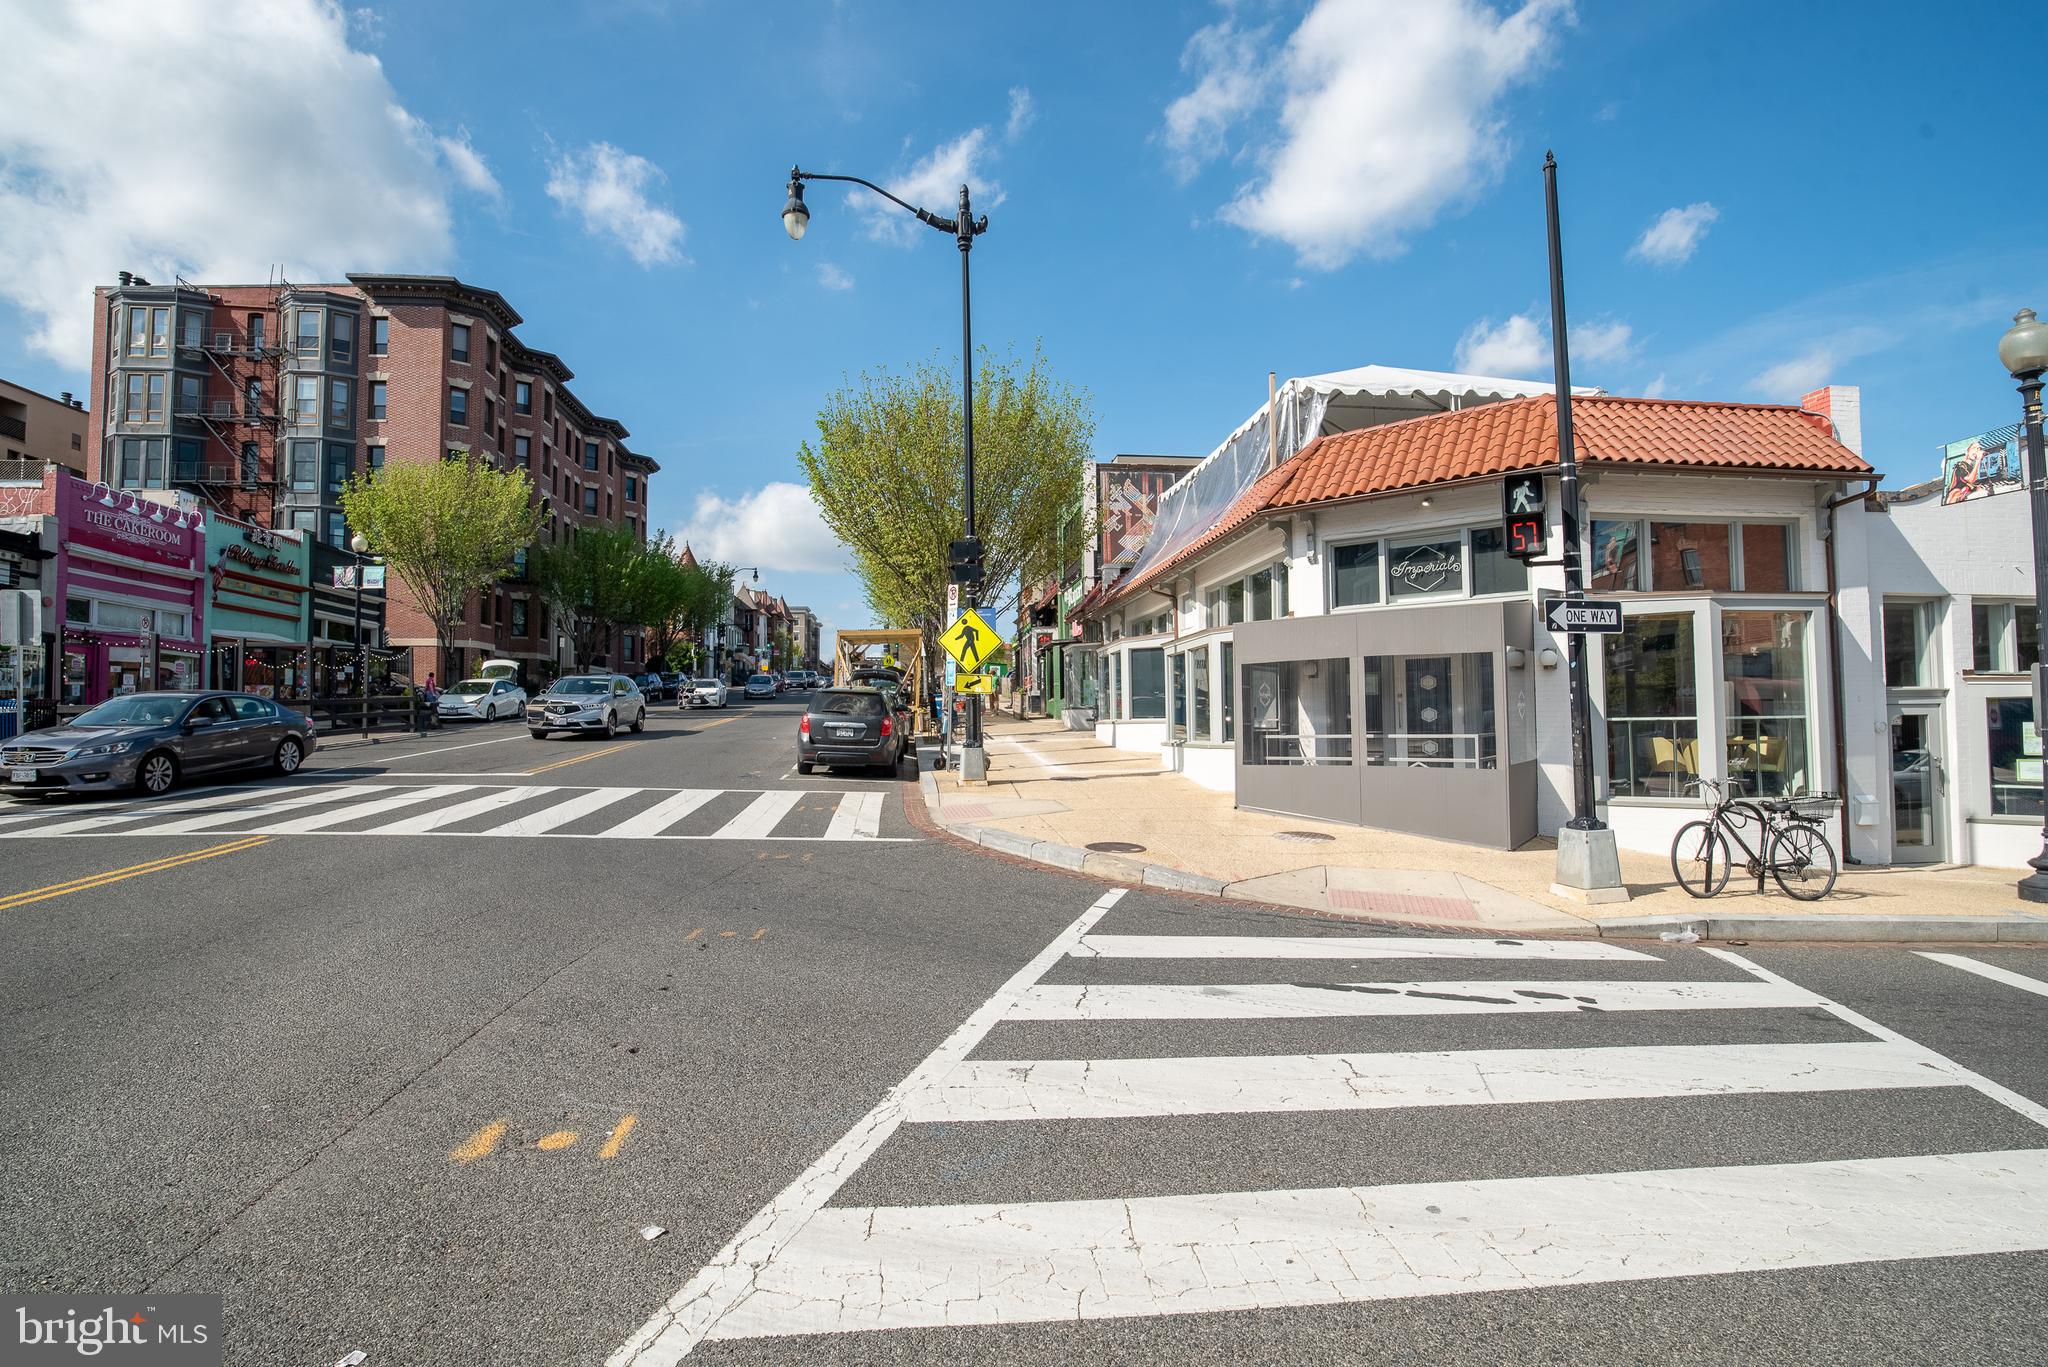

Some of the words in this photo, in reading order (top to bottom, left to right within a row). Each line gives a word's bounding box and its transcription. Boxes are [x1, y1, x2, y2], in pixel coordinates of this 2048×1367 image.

[84, 508, 112, 528] THE
[114, 517, 182, 546] CAKEROOM
[1512, 521, 1538, 551] 57
[1390, 554, 1462, 579] Imperial
[1566, 609, 1587, 623] ONE
[1590, 610, 1614, 623] WAY
